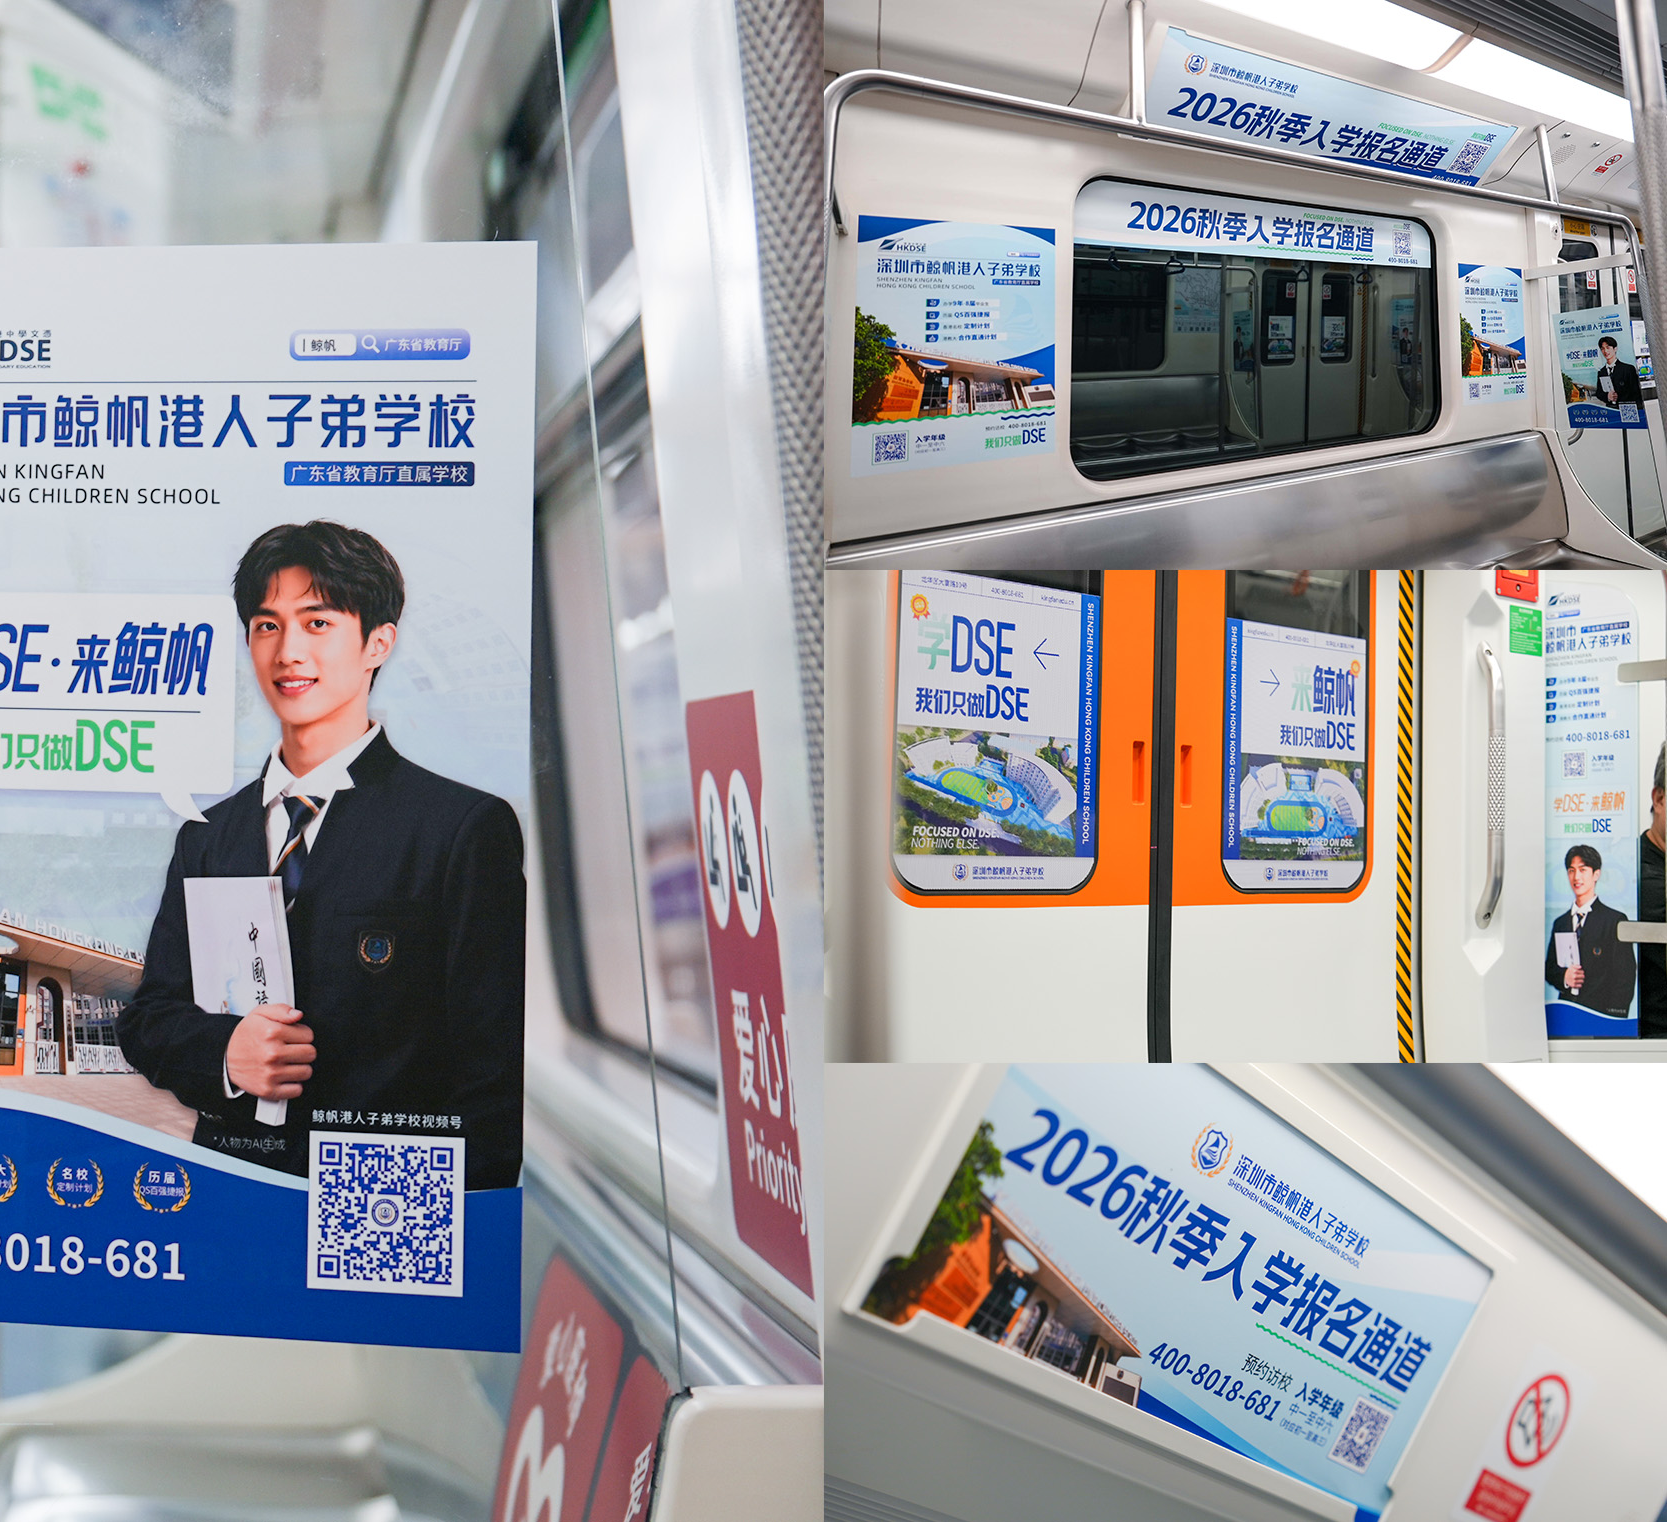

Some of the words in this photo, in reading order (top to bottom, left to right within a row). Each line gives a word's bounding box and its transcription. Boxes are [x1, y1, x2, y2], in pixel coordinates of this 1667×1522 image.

[1210, 62, 1299, 94] 深圳市鲸帆港人子弟学校
[1167, 87, 1449, 172] 2026秋季入学报名通道
[1378, 122, 1404, 134] FOCUSED
[1127, 200, 1375, 253] 2026秋季入学报名通道
[1303, 212, 1326, 220] FOCUSED
[896, 244, 926, 252] HKDSE
[877, 258, 1041, 278] 深圳市鲸帆港人子弟学校
[311, 339, 337, 352] 鲸帆
[384, 338, 463, 352] 广东省教育厅
[1008, 421, 1047, 429] 400-8018-681
[915, 434, 946, 443] 入学年级
[985, 428, 1046, 449] 我们只做DSE
[15, 464, 105, 480] KINGFAN
[290, 464, 469, 483] 广东省教育厅直属学校
[28, 488, 129, 504] CHILDREN
[137, 488, 221, 505] SCHOOL
[1087, 602, 1095, 652] SHENZHEN
[1545, 625, 1577, 640] 深圳市
[917, 612, 1016, 679] 学DSE
[1230, 626, 1238, 672] SHENZHEN
[1545, 632, 1632, 653] 鲸帆港人子弟学校
[1086, 654, 1094, 696] KINGFAN
[915, 684, 1030, 722] 我们只做DSE
[1291, 663, 1355, 717] 来鲸帆
[1085, 698, 1093, 726] HONG
[1084, 728, 1092, 754] KONG
[1280, 721, 1356, 751] 我们只做DSE
[1565, 729, 1631, 742] 400-8018-681
[1083, 756, 1091, 804] CHILDREN
[912, 825, 959, 837] FOCUSED
[961, 826, 977, 838] ON
[1082, 806, 1091, 844] SCHOOL
[911, 837, 954, 849] NOTHING
[1298, 838, 1328, 847] FOCUSED
[1329, 838, 1339, 847] ON
[731, 988, 798, 1131] 爱心
[311, 1109, 463, 1130] 鲸帆港人子弟学校视频号
[61, 1167, 89, 1181] 名校
[148, 1170, 176, 1184] 历届
[744, 1118, 808, 1236] Priority
[56, 1182, 93, 1194] 定制计划
[1233, 1154, 1370, 1258] 深圳市鲸帆港人子弟学校
[1228, 1178, 1259, 1203] SHENZHEN
[1258, 1199, 1284, 1219] KINGFAN
[1282, 1214, 1300, 1230] HONG
[1299, 1223, 1316, 1239] KONG
[1315, 1235, 1341, 1256] CHILDREN
[1340, 1251, 1360, 1269] SCHOOL
[1005, 1109, 1432, 1392] 2026秋季入学报名通道
[1149, 1342, 1281, 1421] 400-8018-681
[1241, 1353, 1294, 1393] 预约访校
[1295, 1382, 1344, 1419] 入学年级
[1289, 1402, 1334, 1435] 中一至中六
